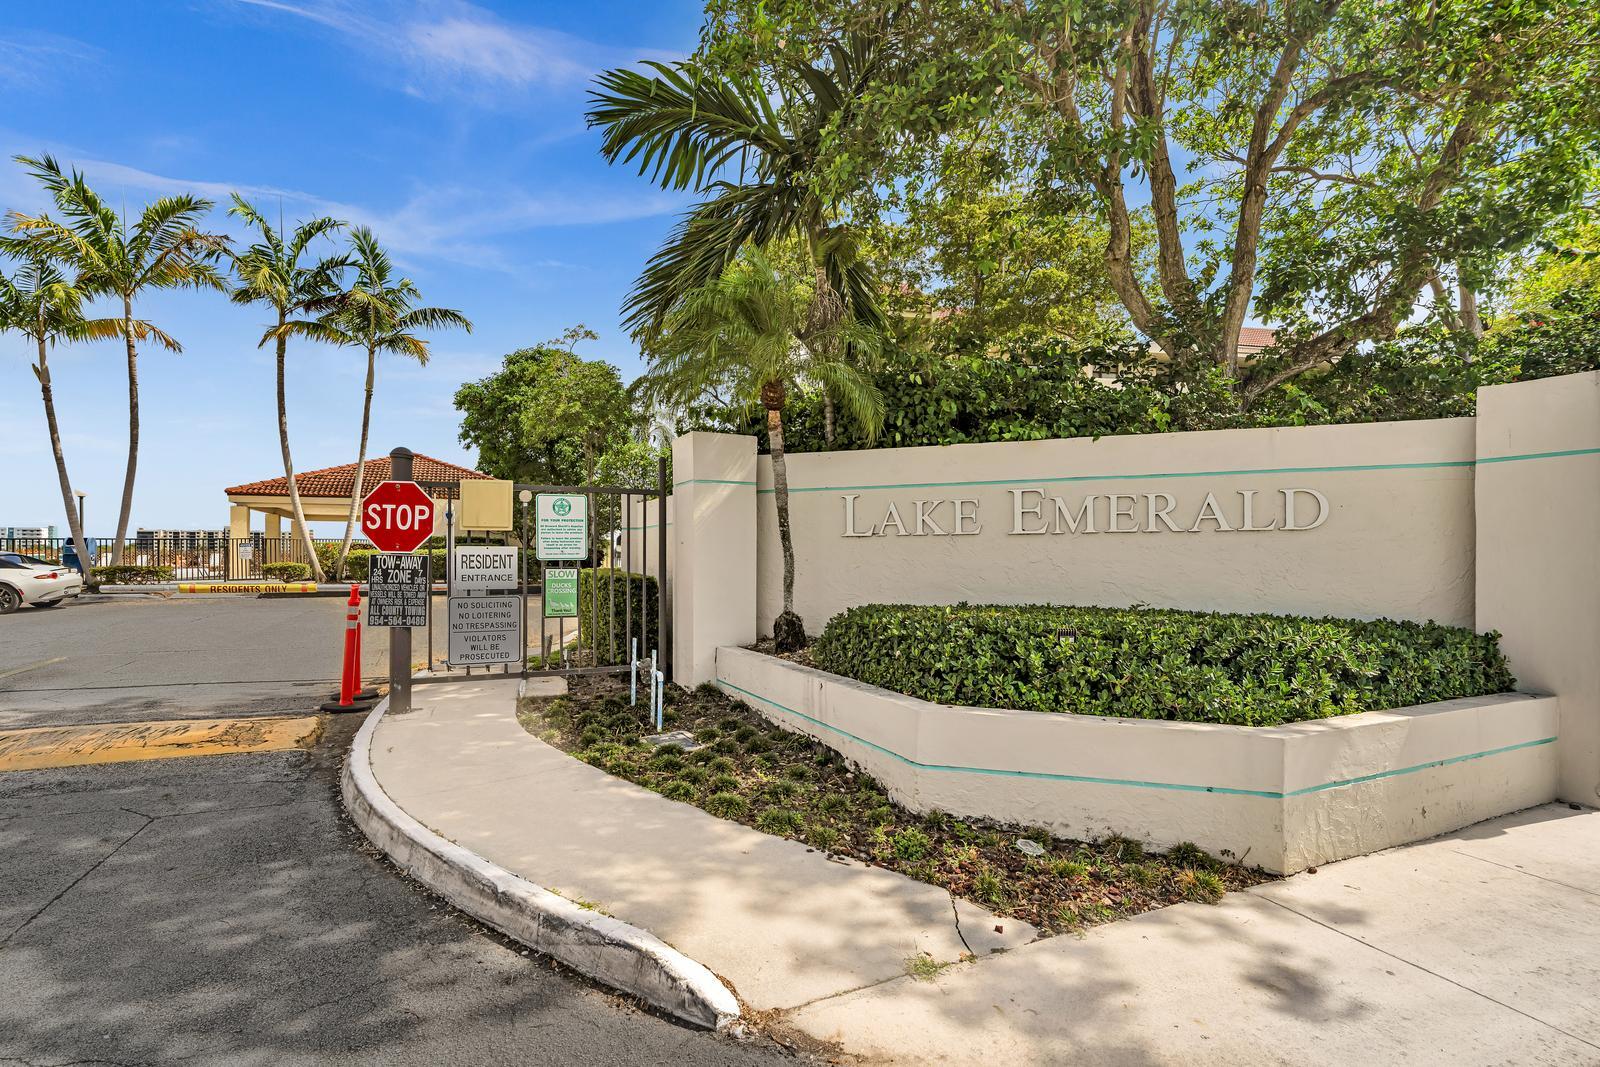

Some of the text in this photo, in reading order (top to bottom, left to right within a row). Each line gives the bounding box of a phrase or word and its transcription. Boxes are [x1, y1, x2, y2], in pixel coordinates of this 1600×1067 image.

[366, 503, 430, 530] STOP
[840, 488, 1330, 537] LAKE EMERALD
[376, 555, 423, 570] TOW-AWAY
[461, 554, 514, 569] RESIDENT
[373, 568, 382, 576] 24
[387, 569, 412, 583] ZONE
[548, 570, 575, 578] SLOW
[414, 577, 426, 585] DAYS
[461, 574, 513, 582] ENTRANCE
[210, 585, 288, 593] RESIDENTS ONLY
[400, 584, 419, 592] VEHICLES
[419, 584, 426, 592] OR
[470, 601, 513, 609] SOLICITING
[370, 605, 426, 616] ALL COUNTY TOWING
[458, 611, 512, 620] NO LOITERING
[466, 621, 517, 630] TRESPASSING
[463, 634, 507, 642] VIOLATORS
[460, 652, 510, 661] PROSECUTED
